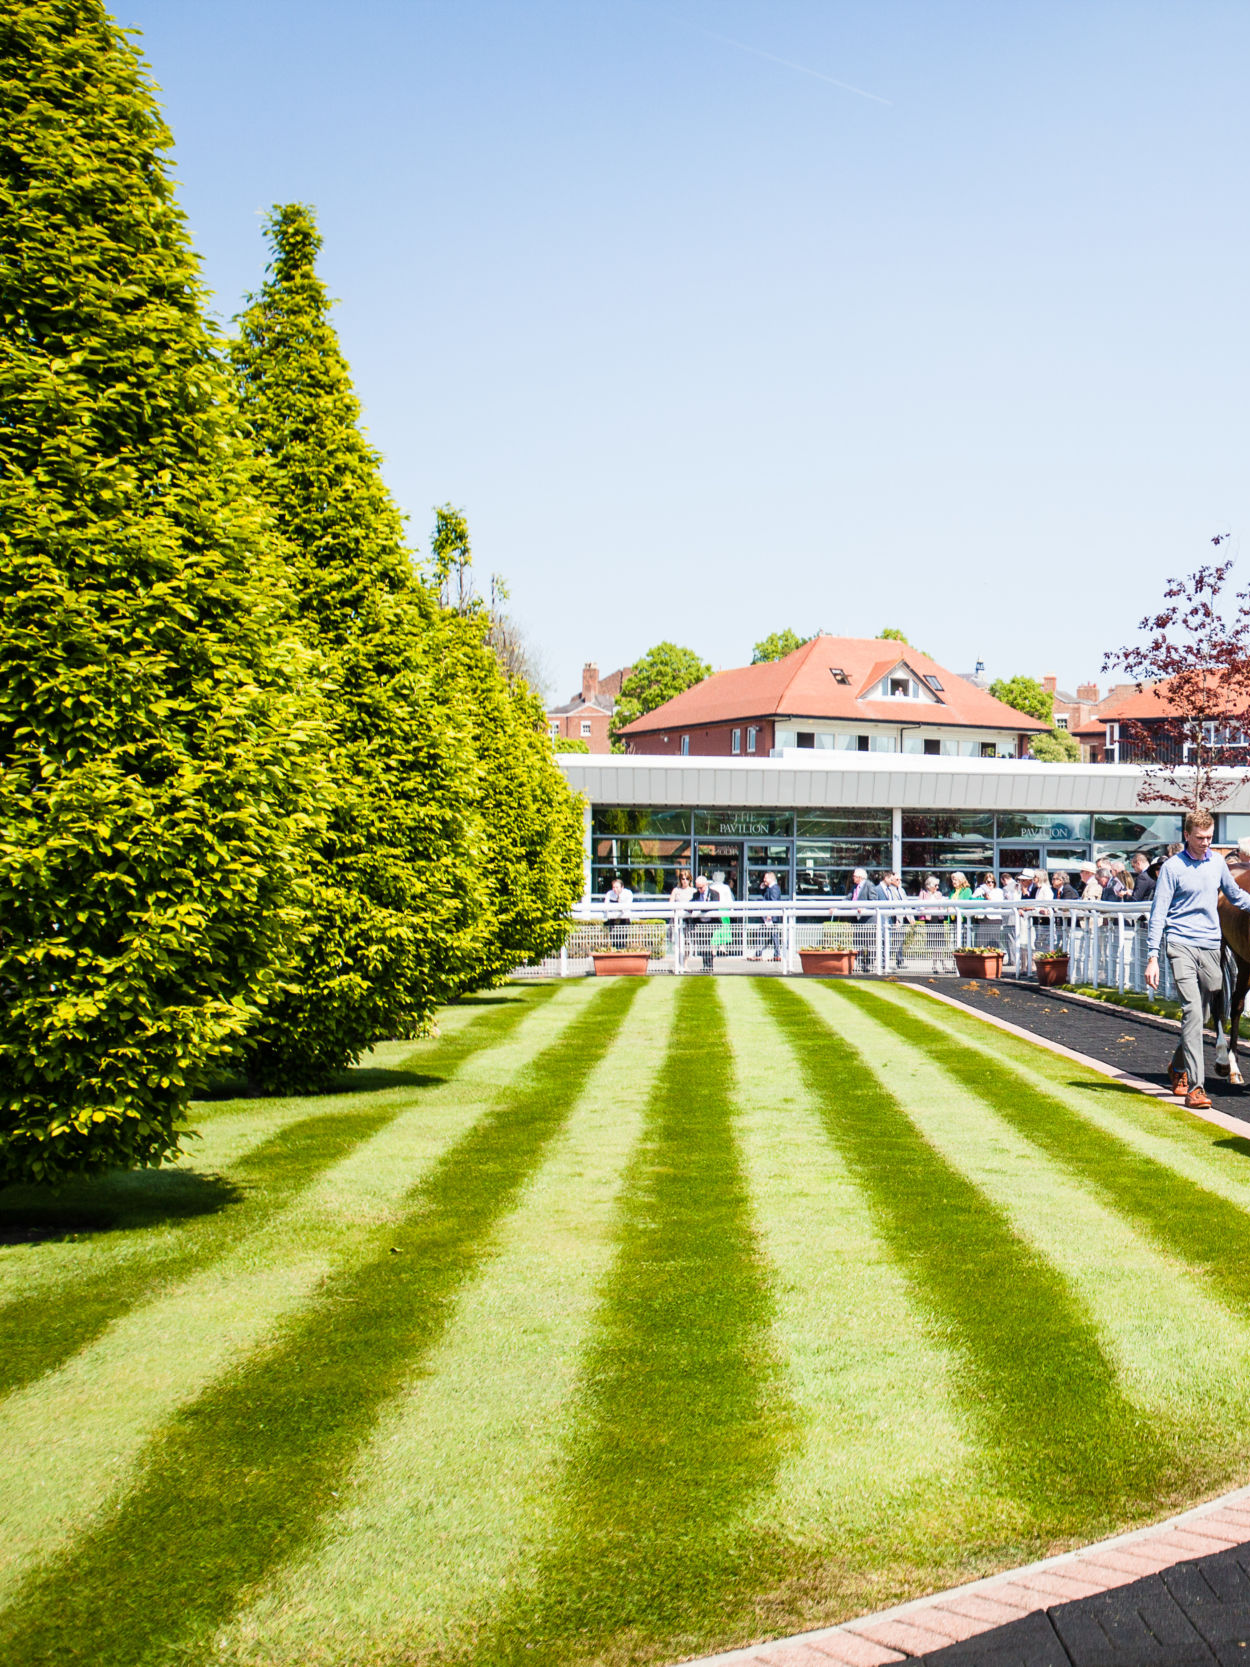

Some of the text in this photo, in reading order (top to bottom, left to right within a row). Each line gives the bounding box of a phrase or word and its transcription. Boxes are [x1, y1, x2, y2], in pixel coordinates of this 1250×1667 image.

[731, 811, 757, 822] THE
[720, 823, 769, 834] PAVILION
[1021, 827, 1068, 838] PAVILION
